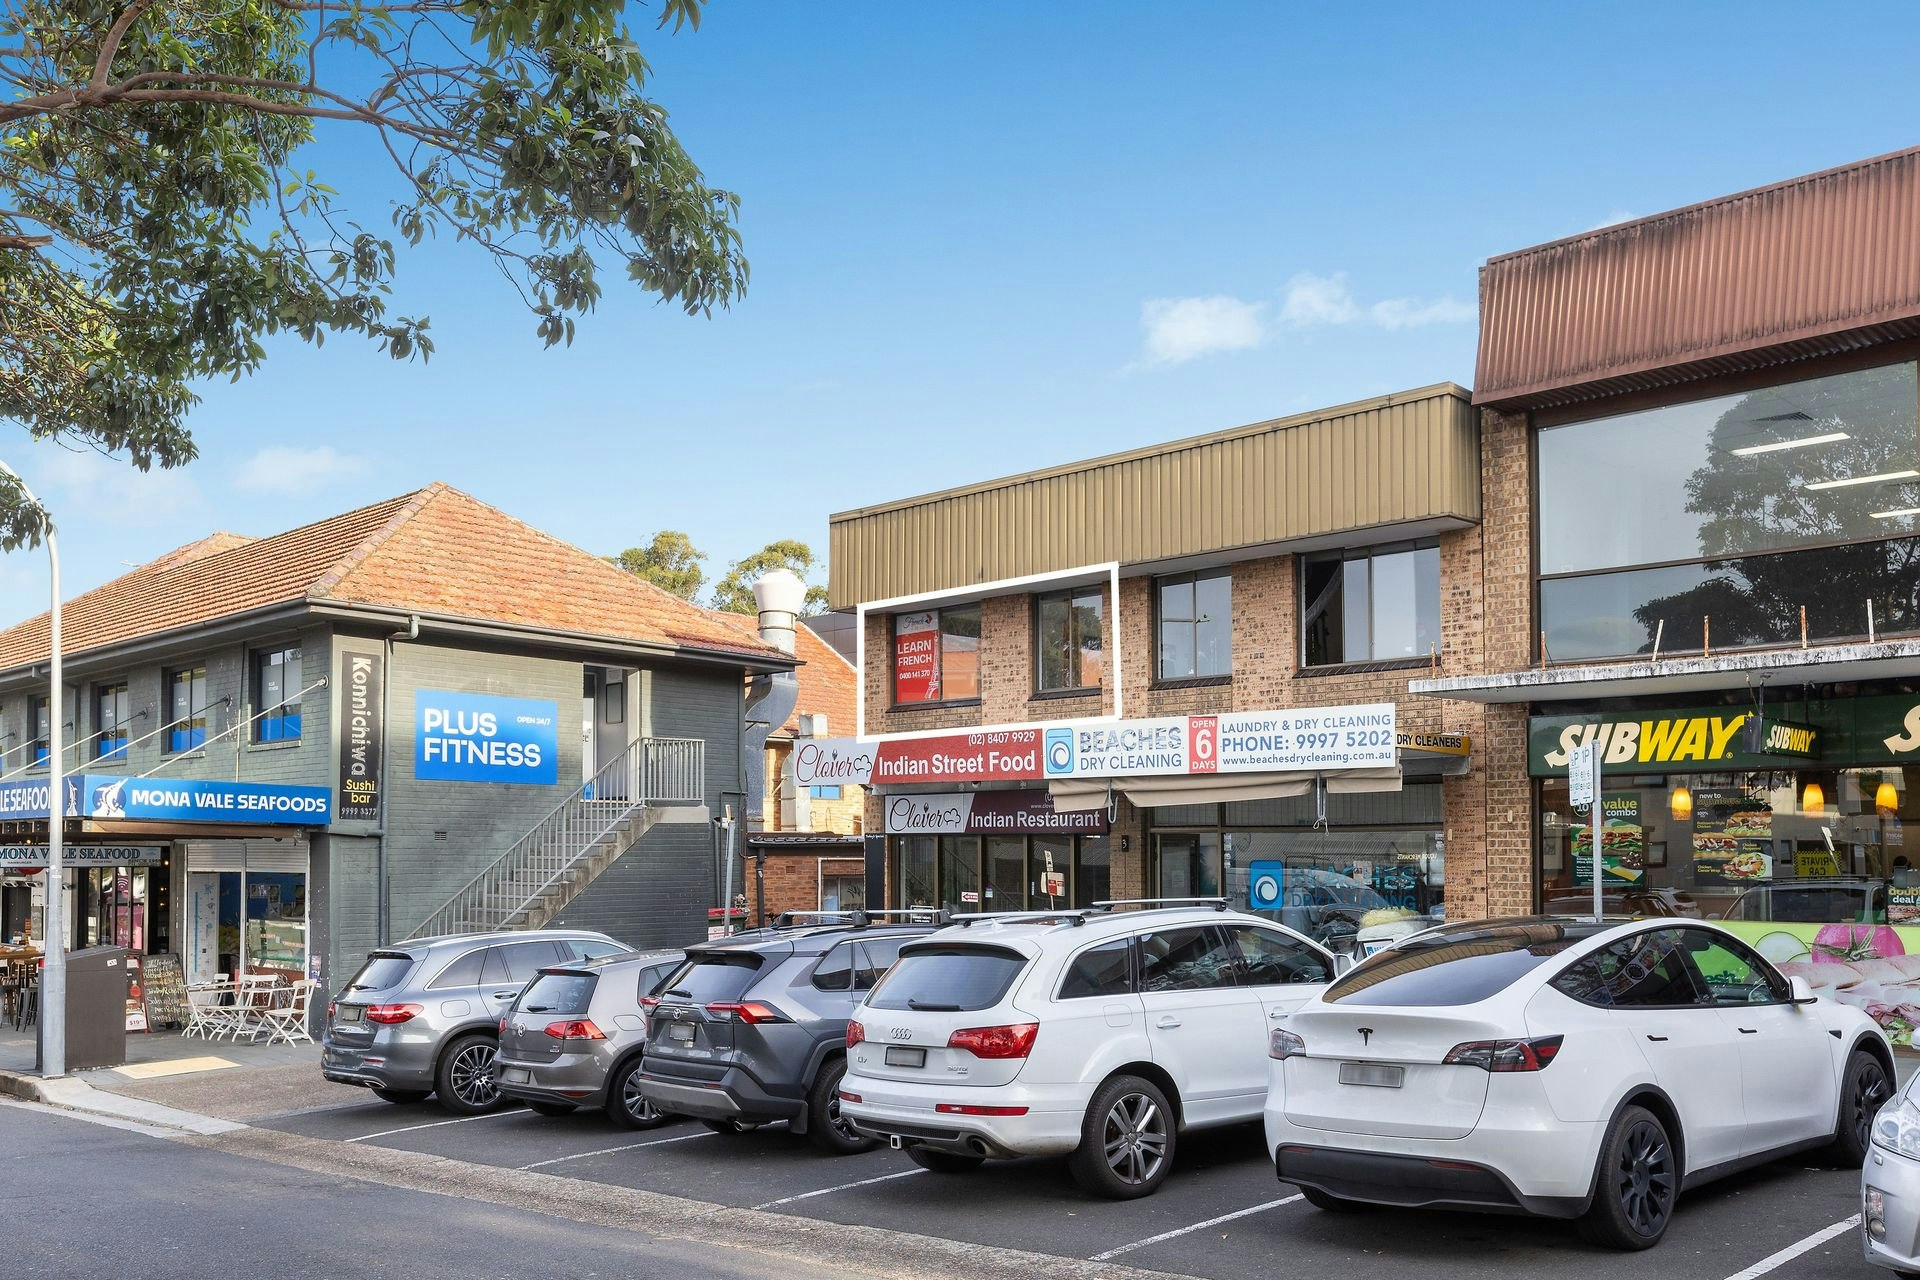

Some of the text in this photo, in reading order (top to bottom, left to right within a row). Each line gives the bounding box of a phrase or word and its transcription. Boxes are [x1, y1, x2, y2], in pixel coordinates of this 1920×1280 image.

[897, 640, 932, 654] LEARN
[898, 654, 932, 666] FRENCH
[900, 672, 911, 680] 0400
[351, 657, 372, 776] Konnichiwa
[424, 708, 497, 737] PLUS
[516, 716, 551, 726] OPEN 24/7
[1192, 720, 1215, 728] OPEN
[1222, 714, 1391, 734] LAUNDRY & DRY CLEANING
[968, 731, 1035, 746] (02) 8407 9929
[1080, 726, 1182, 753] BEACHES
[1195, 729, 1212, 760] 6
[1222, 730, 1391, 752] PHONE: 9997 5202
[1396, 734, 1462, 748] DRY CLEANERS
[1766, 724, 1816, 752] SUBWAY
[424, 737, 542, 768] FITNESS
[1222, 752, 1391, 766] www.beachesdrycleaning.com.au
[796, 744, 854, 782] Clover
[879, 750, 1036, 776] Indian Street Food
[1080, 754, 1182, 770] DRY CLEANING
[1192, 760, 1215, 770] DAYS
[346, 779, 375, 791] Sushi
[10, 786, 51, 811] SEAFOO
[132, 789, 326, 812] MONA VALE SEAFOODS
[351, 792, 371, 804] bar
[1602, 798, 1638, 810] value
[890, 798, 944, 832] Clover
[970, 810, 1100, 828] Indian Restaurant
[37, 848, 77, 860] VLE
[80, 848, 141, 860] SEAFOOD
[1892, 895, 1914, 904] deal
